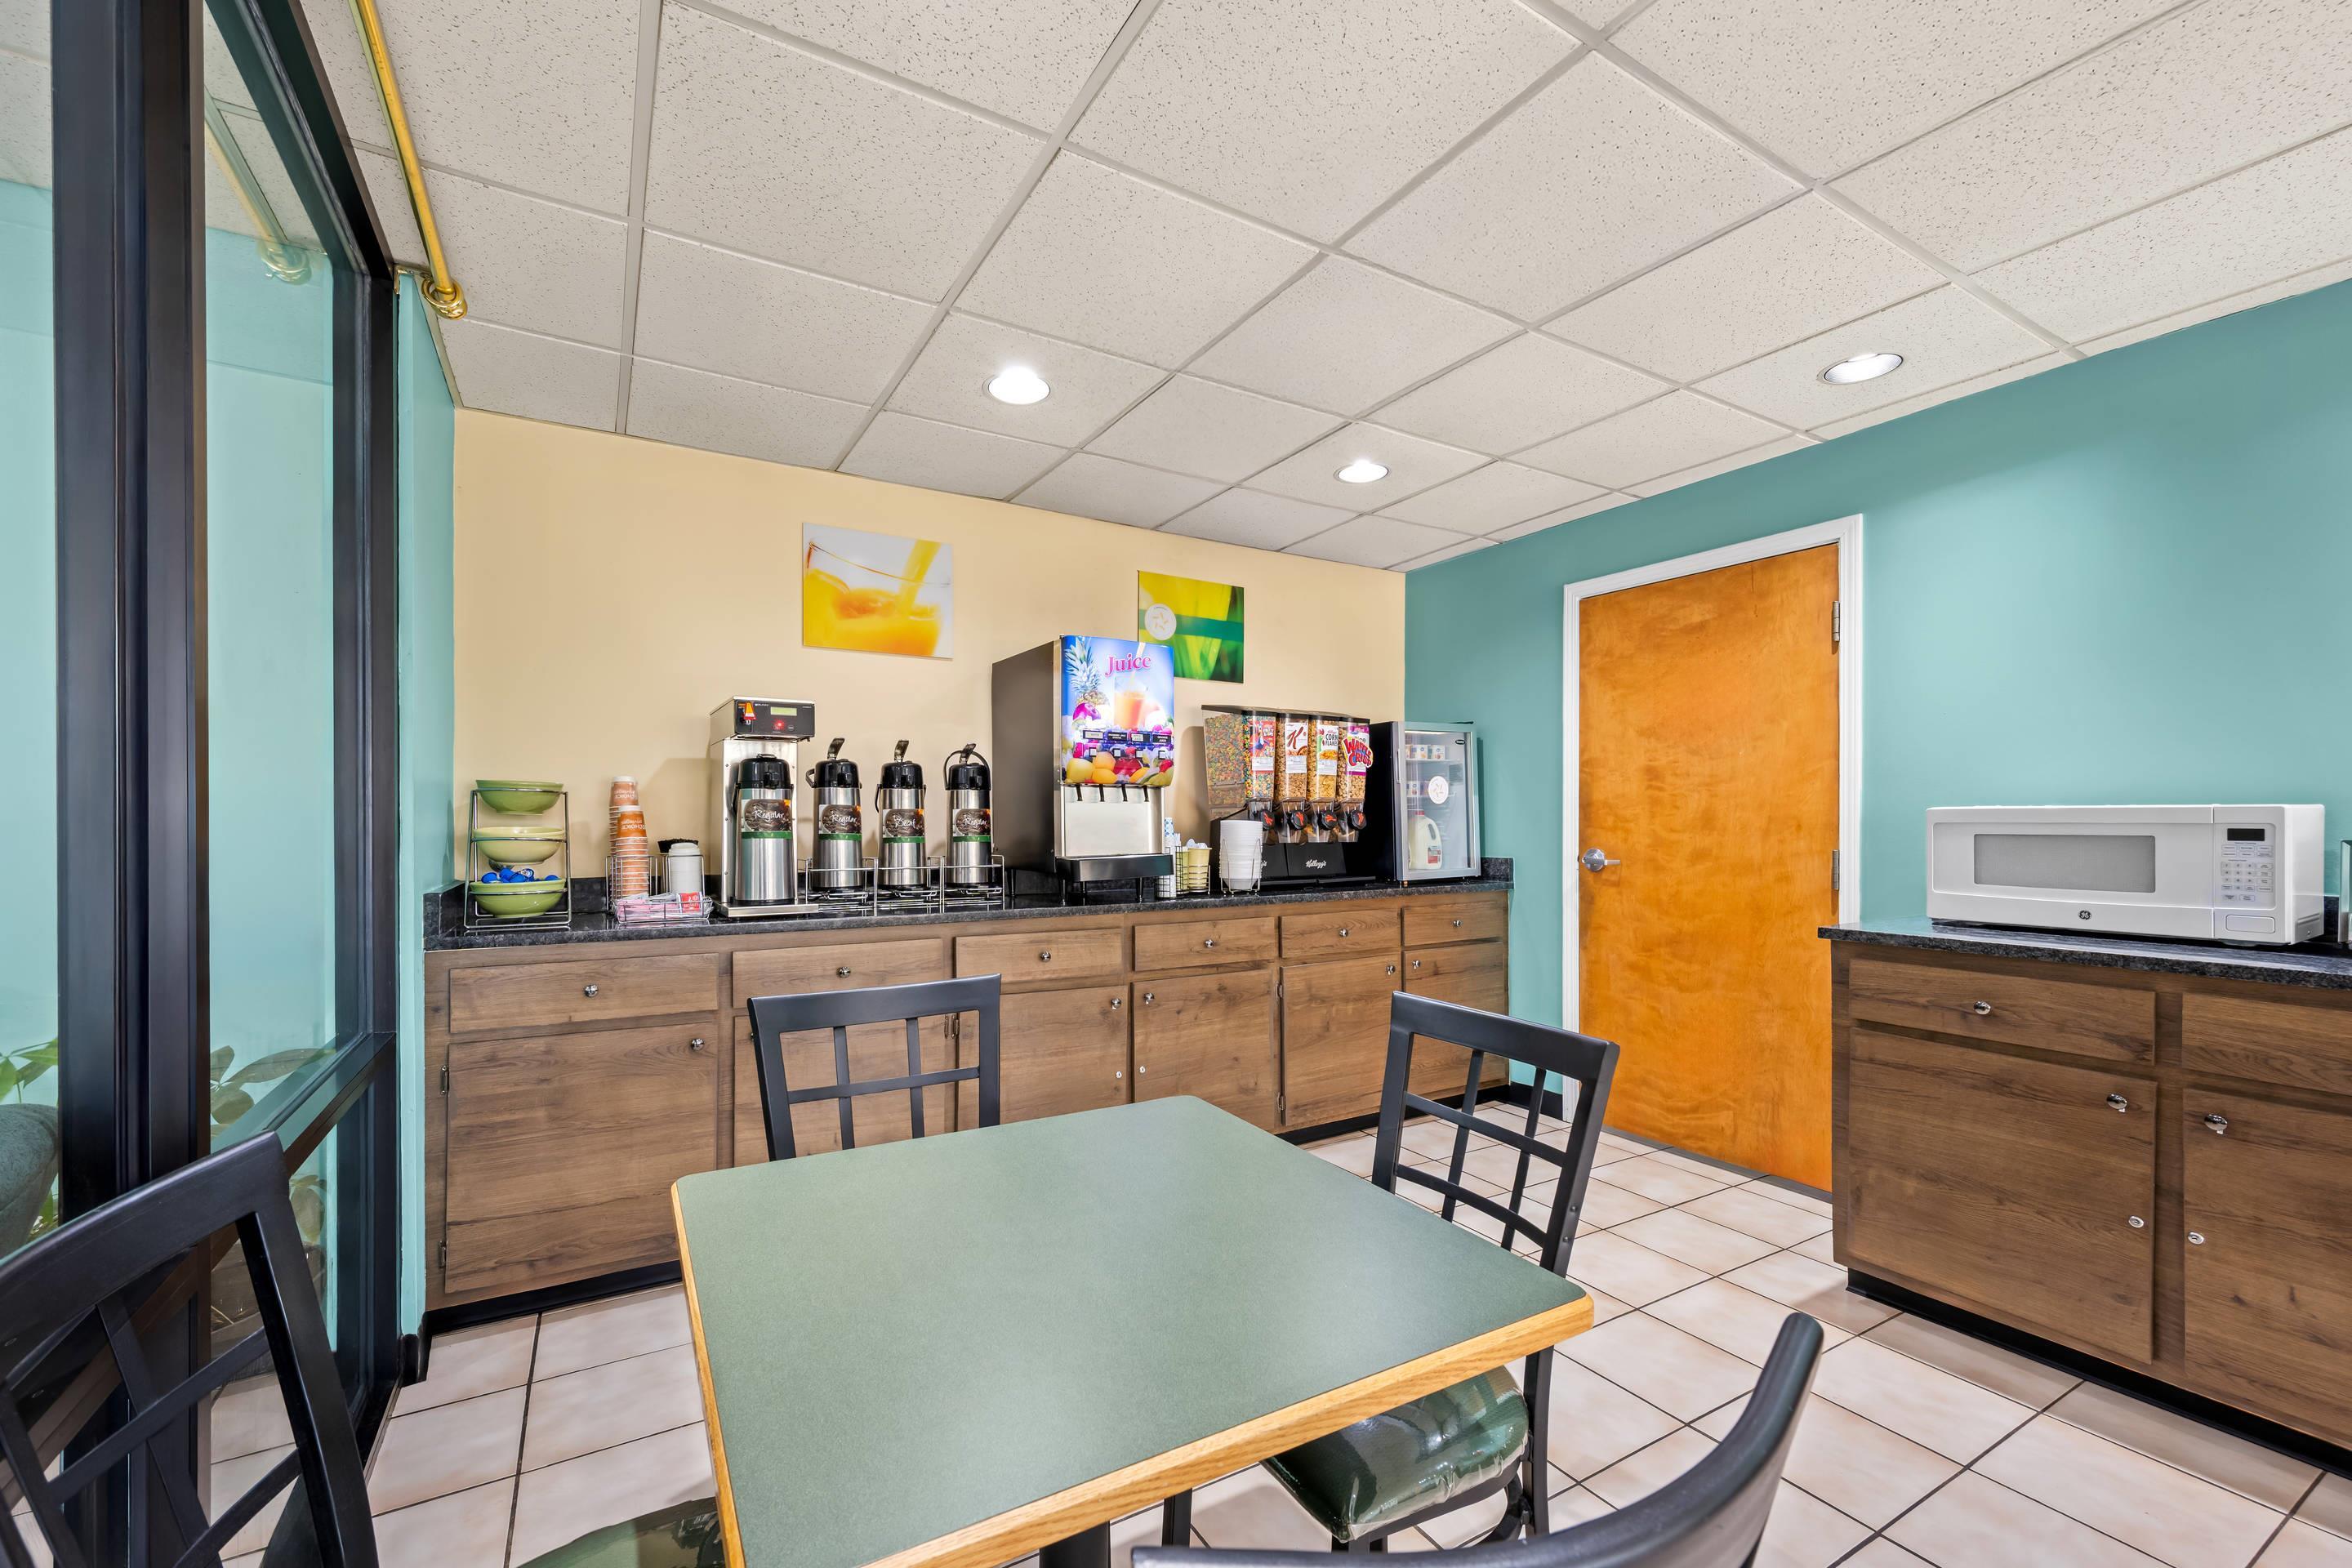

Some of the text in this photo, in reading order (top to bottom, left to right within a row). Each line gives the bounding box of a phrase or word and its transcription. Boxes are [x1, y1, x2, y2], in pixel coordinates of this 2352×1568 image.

[1104, 653, 1152, 677] Juice
[1343, 737, 1372, 758] WAFFLE
[1348, 751, 1372, 767] CRISP
[751, 809, 785, 822] Regular
[829, 814, 858, 826] Regular
[893, 817, 915, 829] Decaf
[962, 817, 987, 828] Regular
[1305, 859, 1327, 870] Kellogg's
